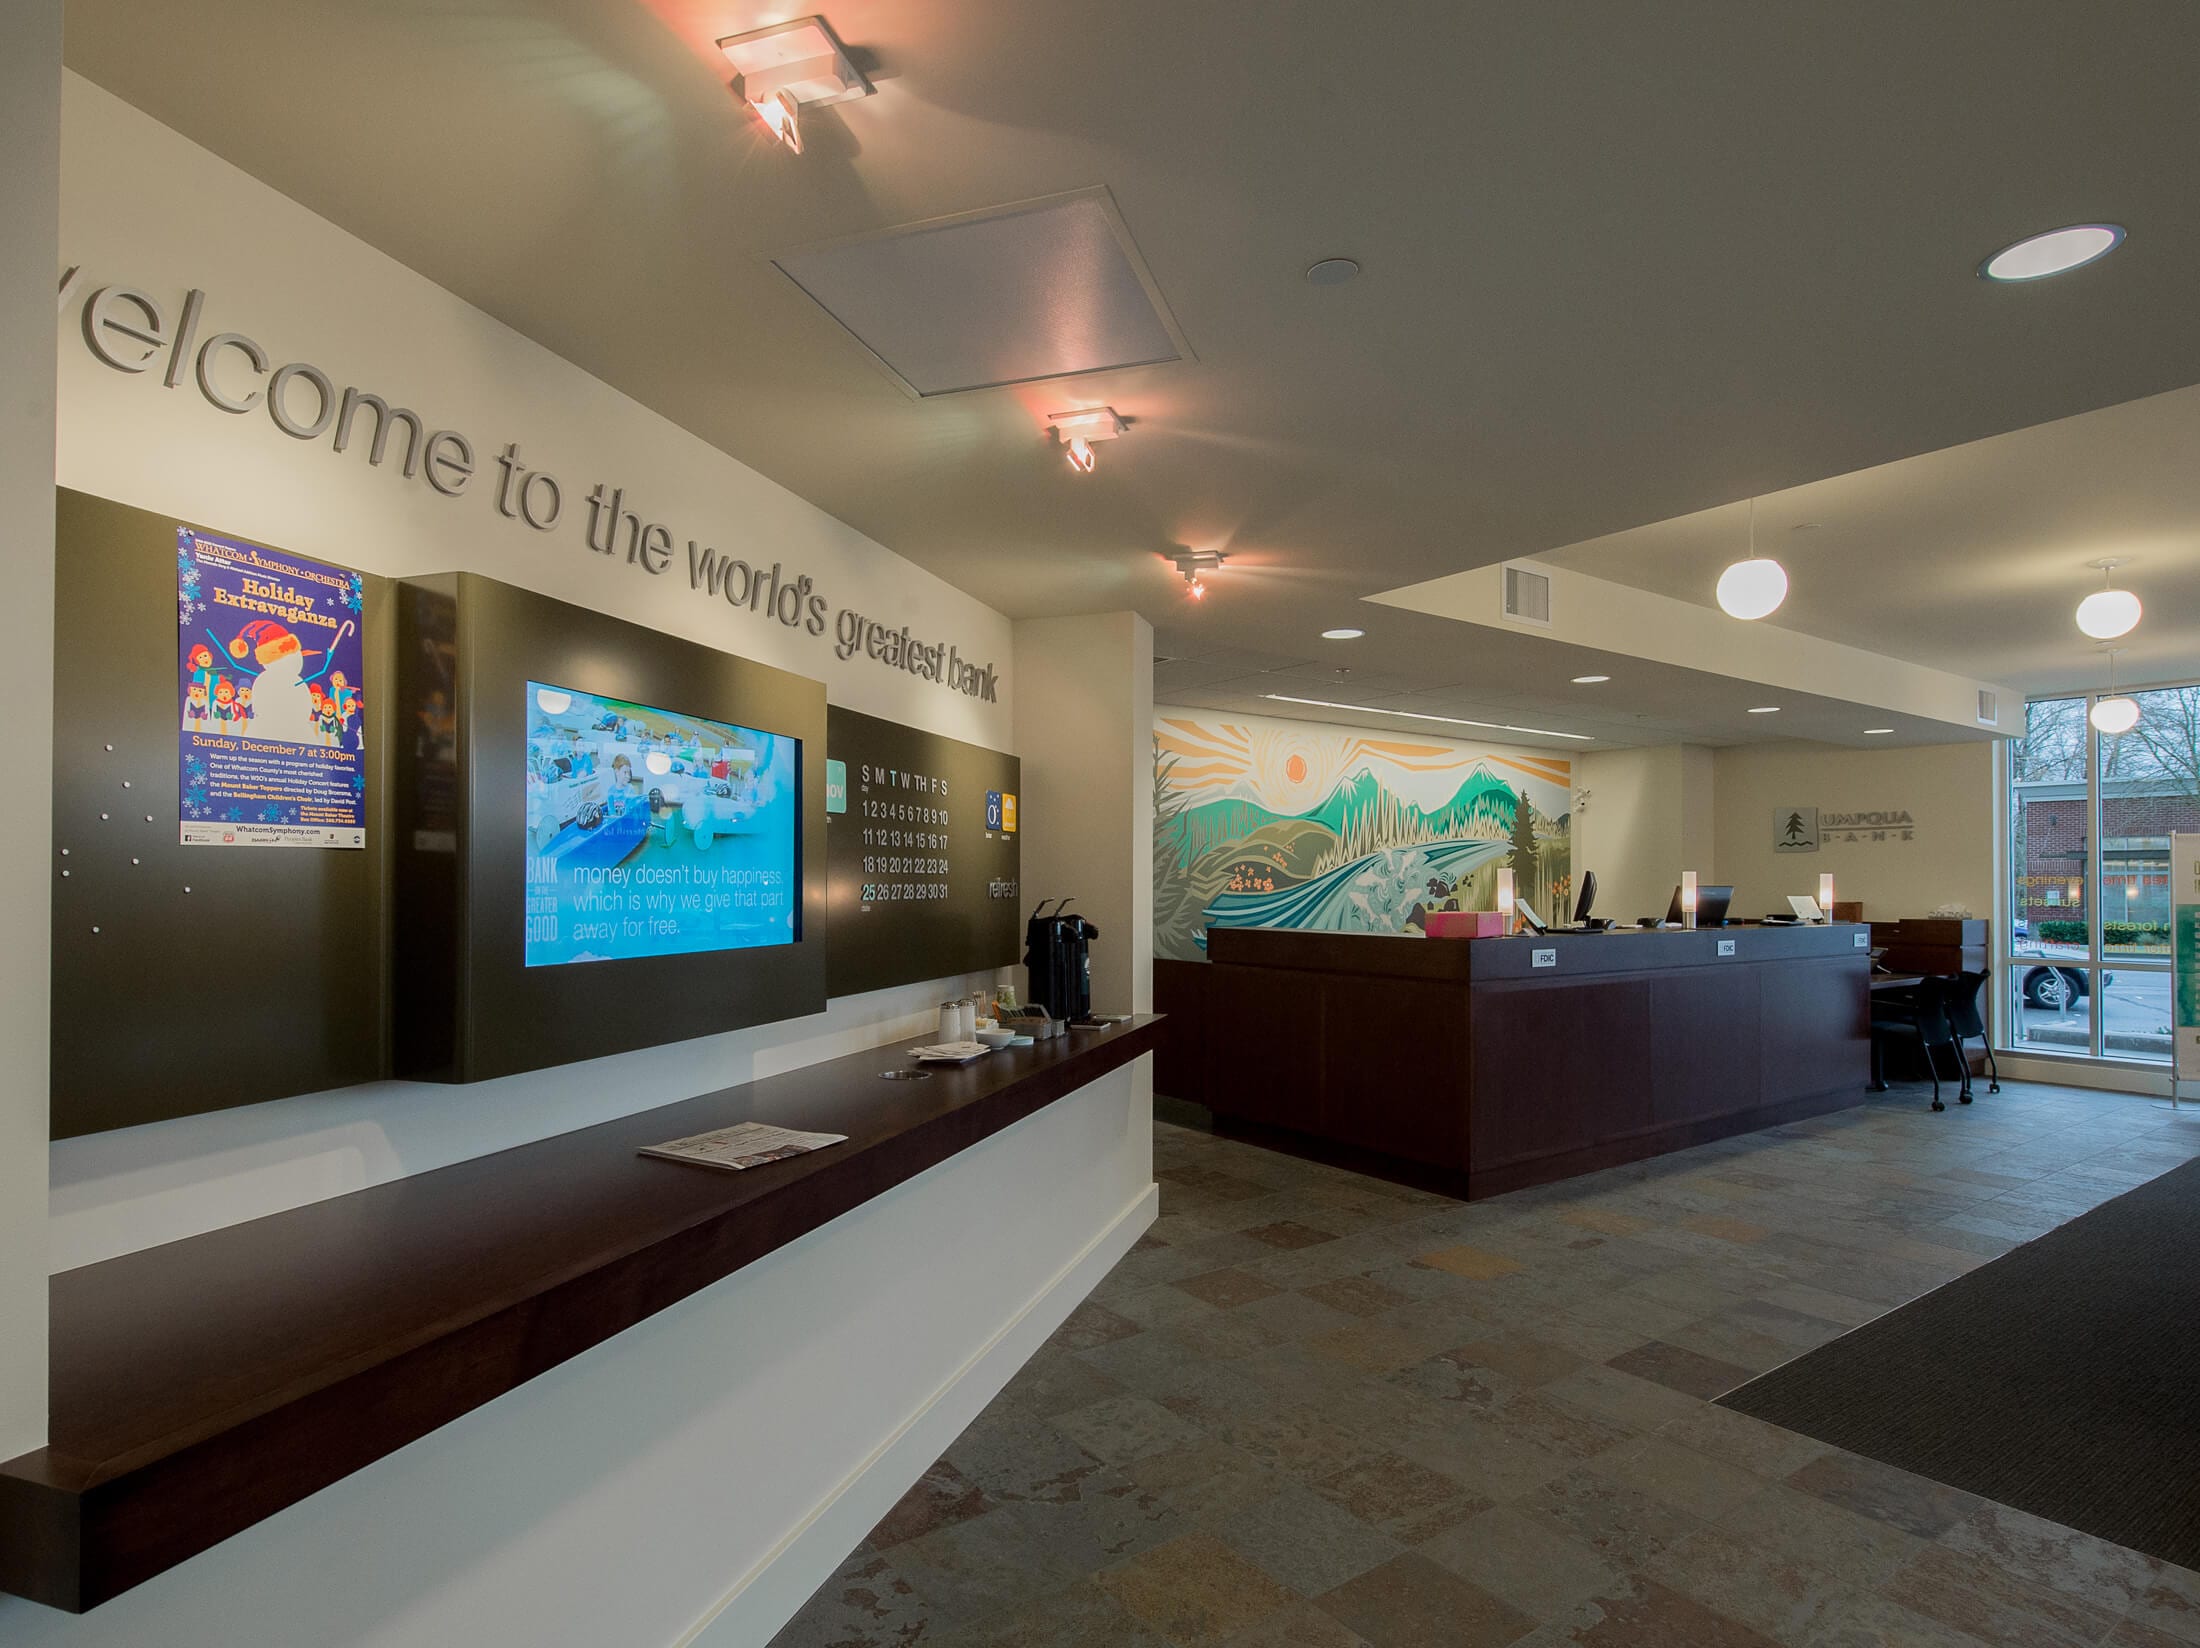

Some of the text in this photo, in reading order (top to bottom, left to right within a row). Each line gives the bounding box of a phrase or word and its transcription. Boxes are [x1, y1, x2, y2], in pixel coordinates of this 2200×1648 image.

[57, 265, 998, 704] elcome to the world's greatest bank
[195, 542, 247, 561] WHATCOM
[251, 550, 299, 575] SYMPHONY
[304, 570, 351, 590] ORCHESTRA
[242, 577, 315, 611] Holiday
[213, 587, 338, 629] Extravaganza
[192, 735, 356, 763] Sunday, December 7 at 3:00pm
[287, 778, 308, 786] Holiday
[313, 788, 328, 796] Doug
[862, 764, 948, 796] S M T W TH F S
[862, 800, 948, 826] 1 2 3 4 5 6 7 8 9 10
[1821, 810, 1913, 826] UMPQUA
[236, 825, 321, 835] WhatcomSymphony.com
[863, 828, 948, 850] 11 12 13 14 15 16 17
[527, 857, 558, 883] BANK
[573, 867, 631, 889] money
[635, 864, 689, 884] doesn't
[693, 865, 718, 889] buy
[863, 855, 949, 875] 18 19 20 21 22 23 24
[862, 883, 948, 901] 25 26 27 28 29 30 31
[989, 877, 1018, 899] refresh
[527, 896, 558, 913] GREATER
[573, 889, 784, 913] which is why we give that part
[526, 915, 558, 943] GOOD
[573, 916, 680, 943] away for free.
[1541, 953, 1554, 963] FDIC
